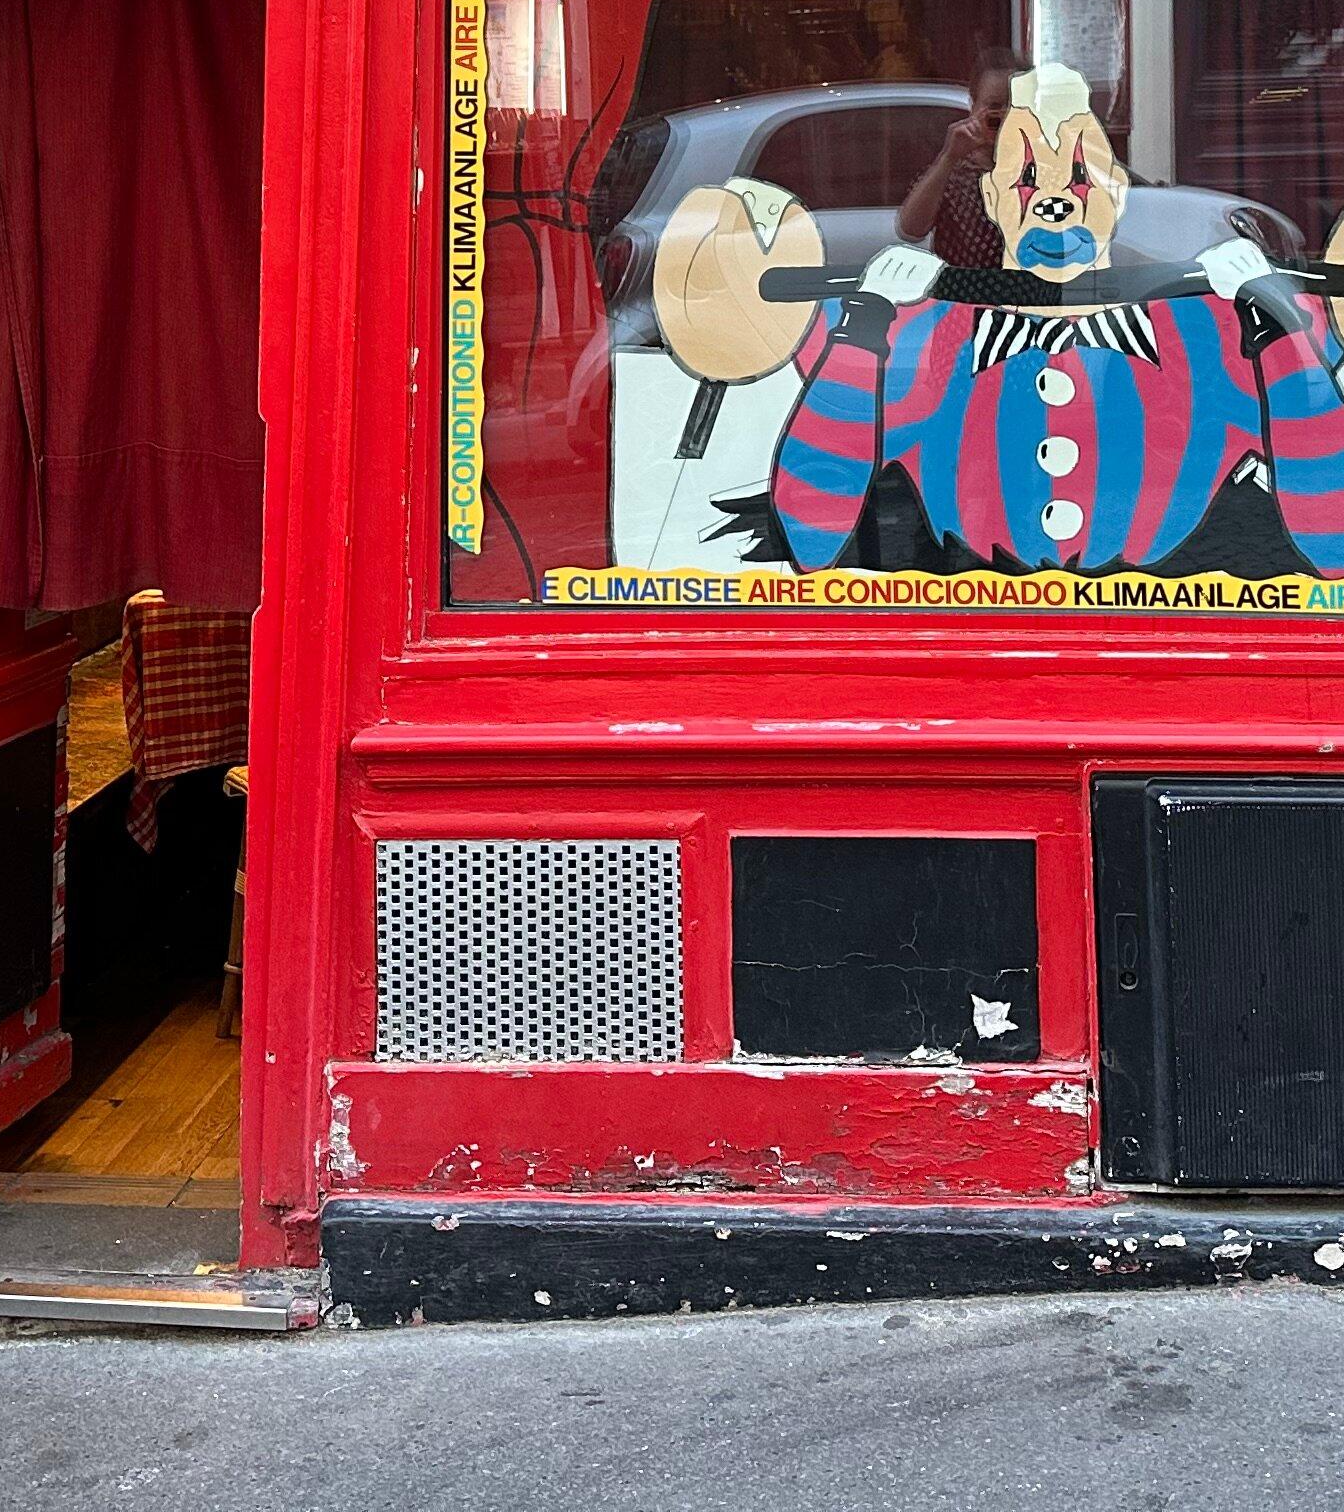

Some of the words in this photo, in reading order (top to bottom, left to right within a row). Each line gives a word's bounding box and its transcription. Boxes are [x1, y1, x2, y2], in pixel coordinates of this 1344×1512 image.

[455, 5, 479, 72] AIRE
[453, 79, 478, 291] KLIMAANLAGE
[567, 576, 742, 603] CLIMATISEE
[748, 578, 816, 603] AIRE
[824, 579, 1067, 606] CONDICIONADO
[1073, 581, 1301, 610] KLIMAANLAGE
